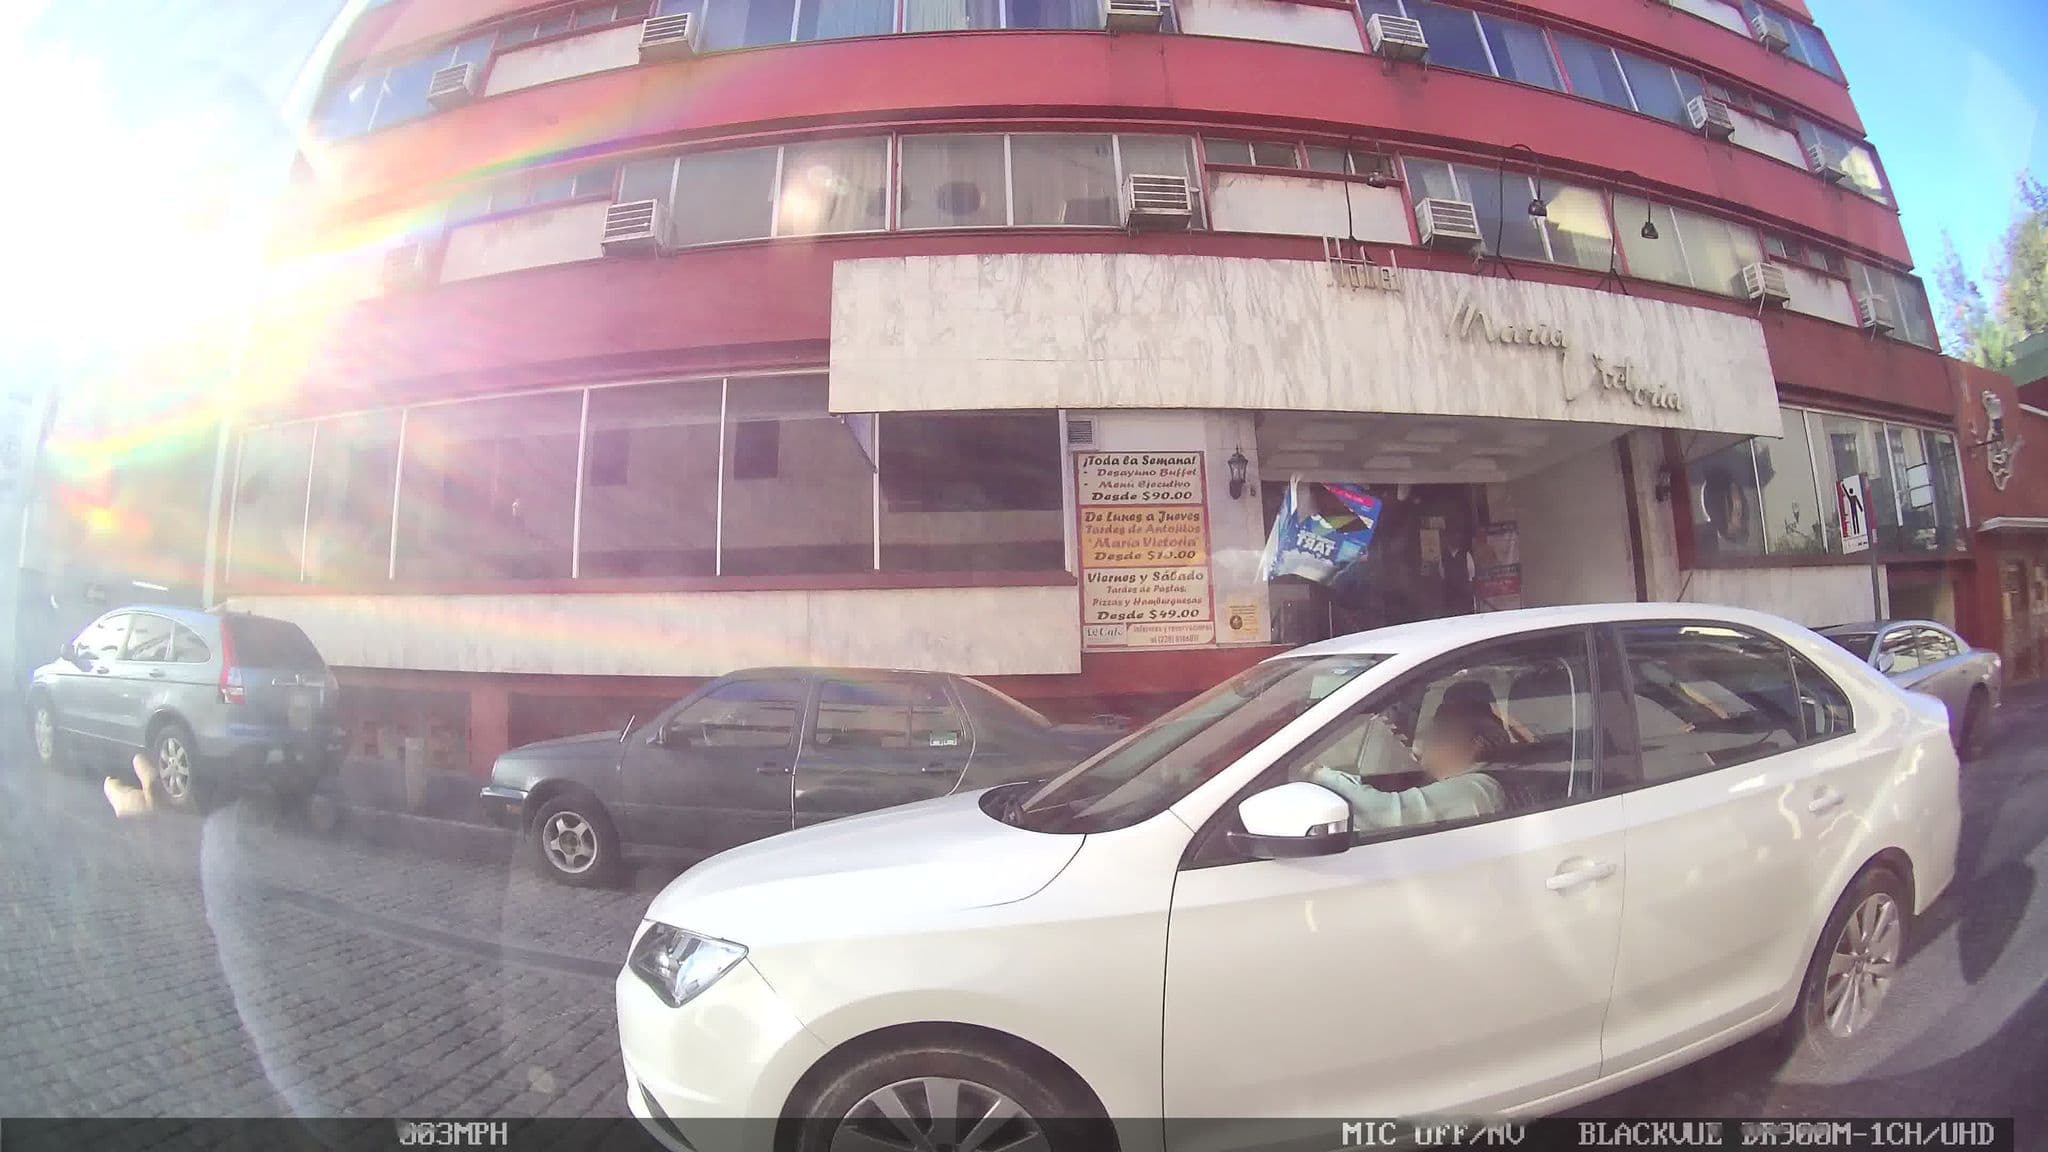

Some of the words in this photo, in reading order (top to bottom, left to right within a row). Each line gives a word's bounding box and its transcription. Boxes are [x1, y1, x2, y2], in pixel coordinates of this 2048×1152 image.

[1083, 455, 1119, 467] ¡Toda
[1123, 456, 1138, 465] la
[1142, 455, 1196, 466] Semana!
[1097, 468, 1156, 477] Desayuno
[1159, 468, 1197, 477] Buffet
[1138, 480, 1191, 489] Ejecutivo
[1092, 492, 1137, 501] Desde
[1142, 491, 1192, 501] $90.00
[1085, 512, 1102, 522] De
[1106, 511, 1142, 522] Lunes
[1146, 513, 1154, 521] a
[1158, 510, 1200, 523] Jueves
[1085, 525, 1125, 535] Tardes
[1128, 525, 1142, 534] de
[1145, 524, 1200, 535] Antojitos
[1094, 551, 1141, 561] Desde
[1087, 572, 1136, 583] Viernes
[1140, 574, 1148, 584] y
[1152, 571, 1204, 581] Sábado
[1106, 586, 1137, 594] Tardes
[1140, 585, 1151, 593] de
[1092, 598, 1124, 607] Pizzas
[1125, 599, 1131, 607] y
[1133, 597, 1202, 606] Hamburguesas
[1097, 610, 1144, 620] Desde
[1149, 609, 1200, 620] $49.00
